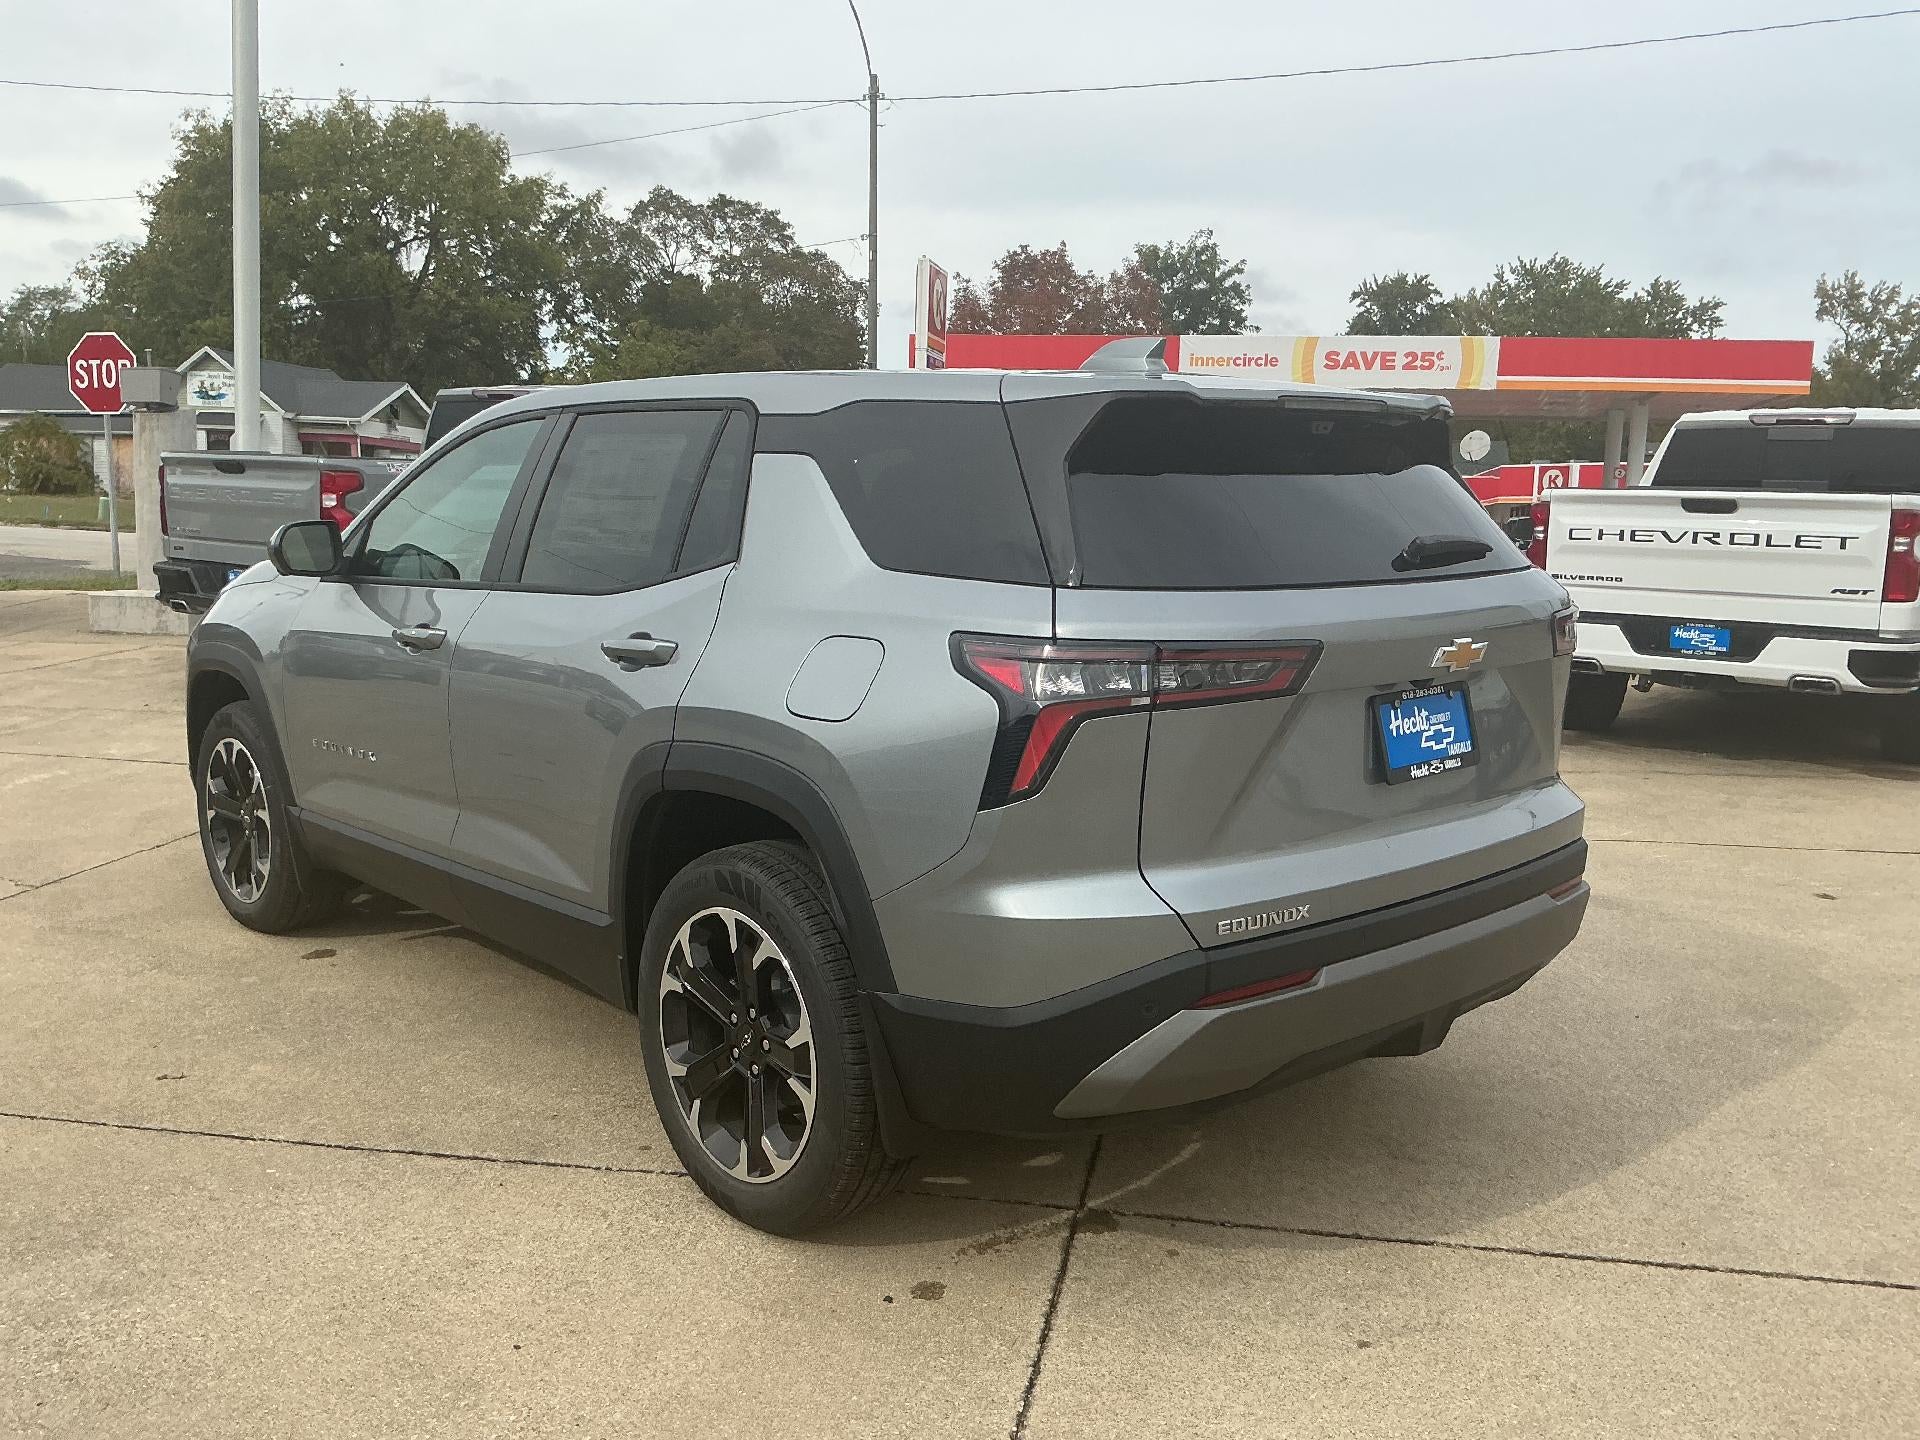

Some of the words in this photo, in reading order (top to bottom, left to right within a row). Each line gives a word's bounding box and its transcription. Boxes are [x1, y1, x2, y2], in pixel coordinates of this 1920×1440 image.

[1189, 353, 1279, 367] innercircle
[1323, 350, 1396, 371] SAVE
[1548, 474, 1561, 488] K
[1568, 527, 1859, 550] CHEVROLET
[1551, 573, 1624, 583] SILVERADO
[1390, 706, 1430, 737] Hecht
[1216, 904, 1310, 935] EQUINOX
